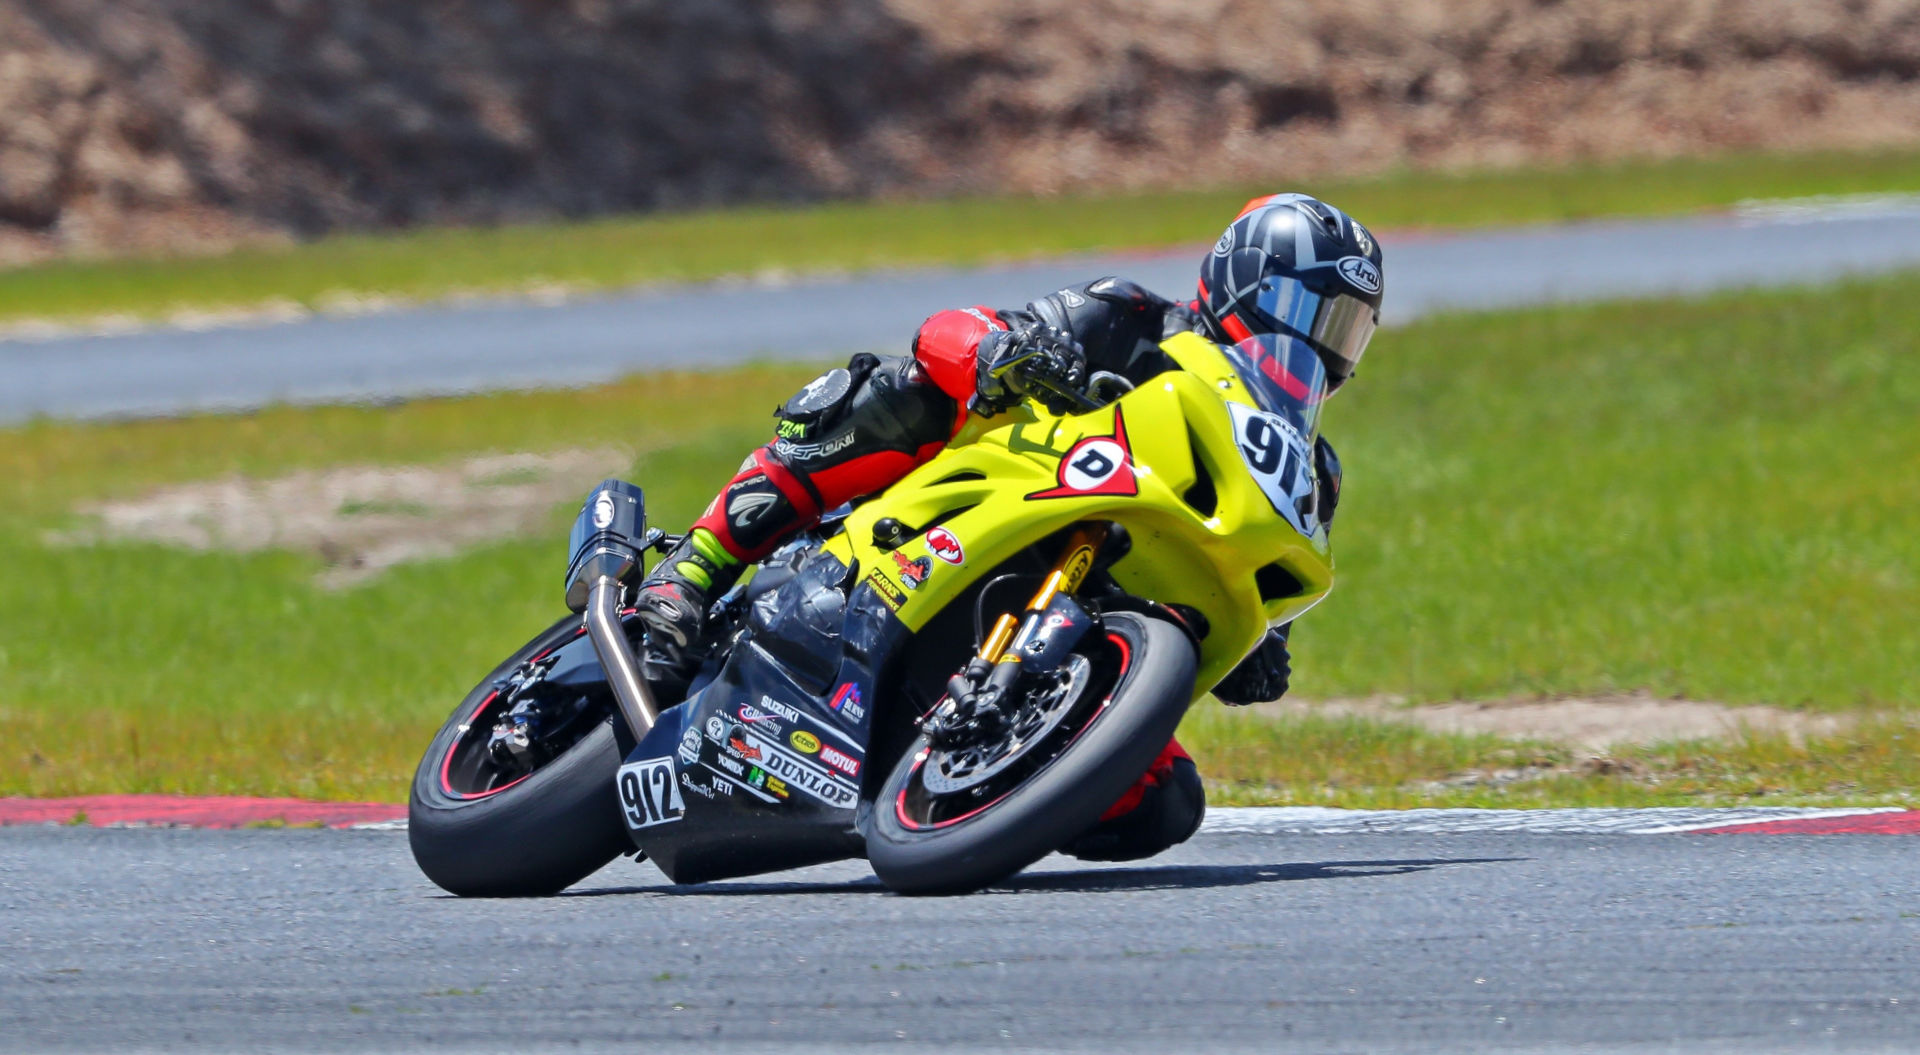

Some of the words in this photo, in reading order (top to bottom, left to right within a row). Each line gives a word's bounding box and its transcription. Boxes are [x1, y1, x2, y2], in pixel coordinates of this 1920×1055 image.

[1343, 261, 1378, 287] Arai
[760, 695, 800, 723] SUZUKI
[821, 747, 858, 774] MOTUL
[711, 775, 733, 796] YETI
[765, 752, 852, 805] DUNLOP
[620, 764, 680, 826] 912
